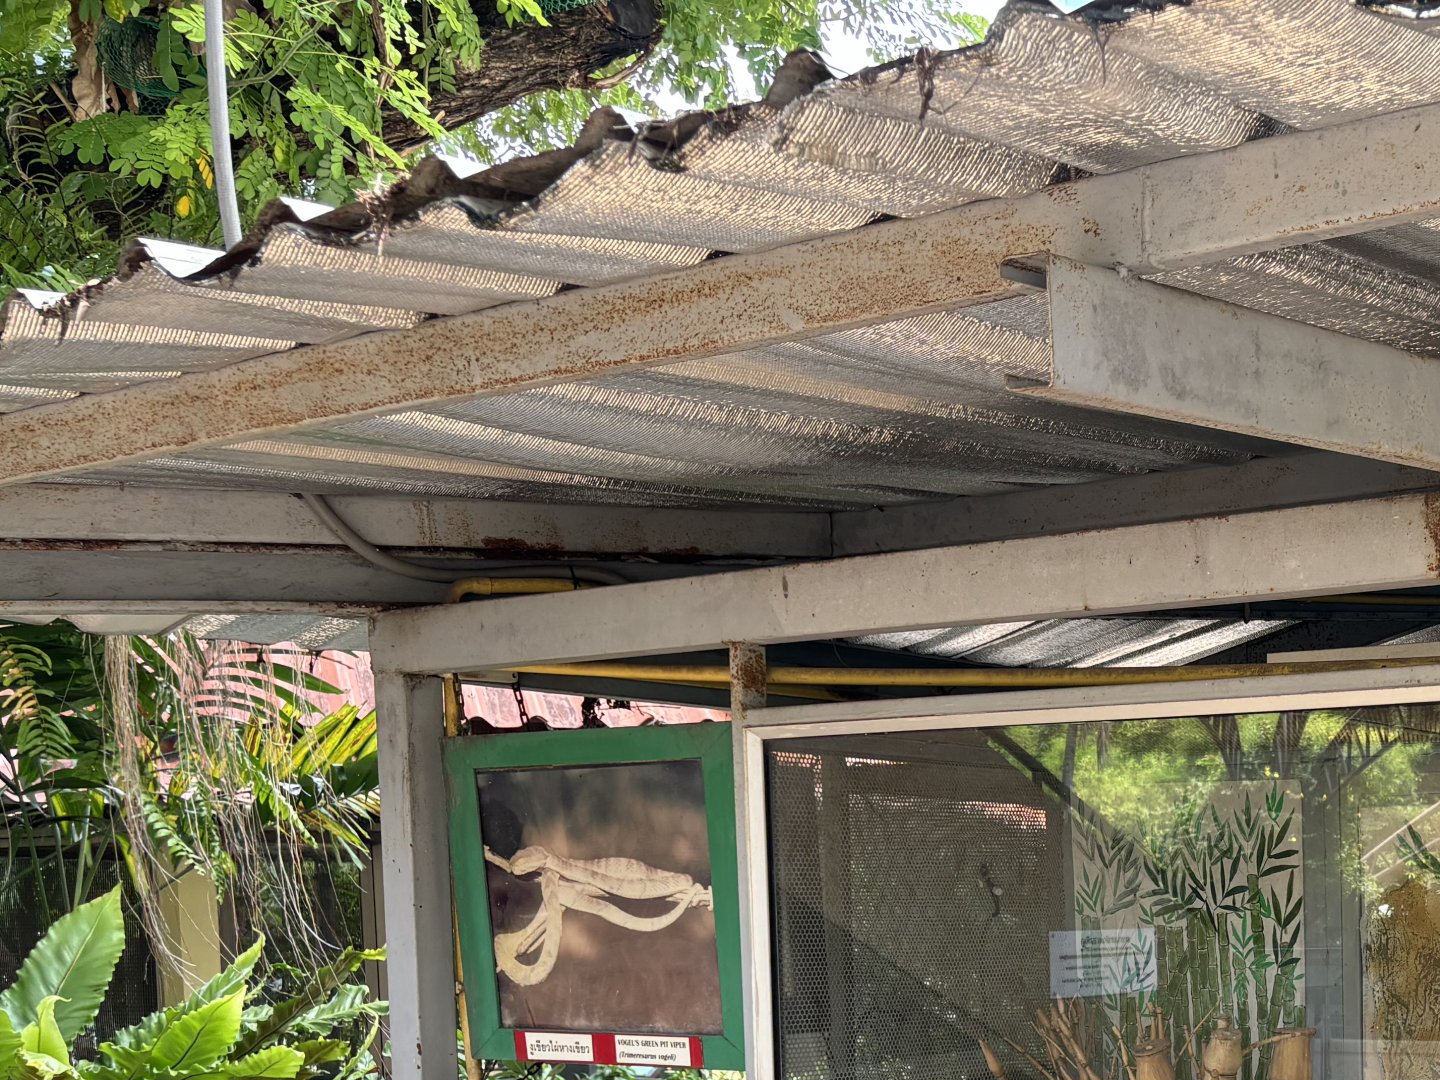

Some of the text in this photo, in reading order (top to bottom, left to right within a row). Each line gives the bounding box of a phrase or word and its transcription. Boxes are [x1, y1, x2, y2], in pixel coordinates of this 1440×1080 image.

[617, 1037, 687, 1049] VOGEL'S GREEN PIT VIPER
